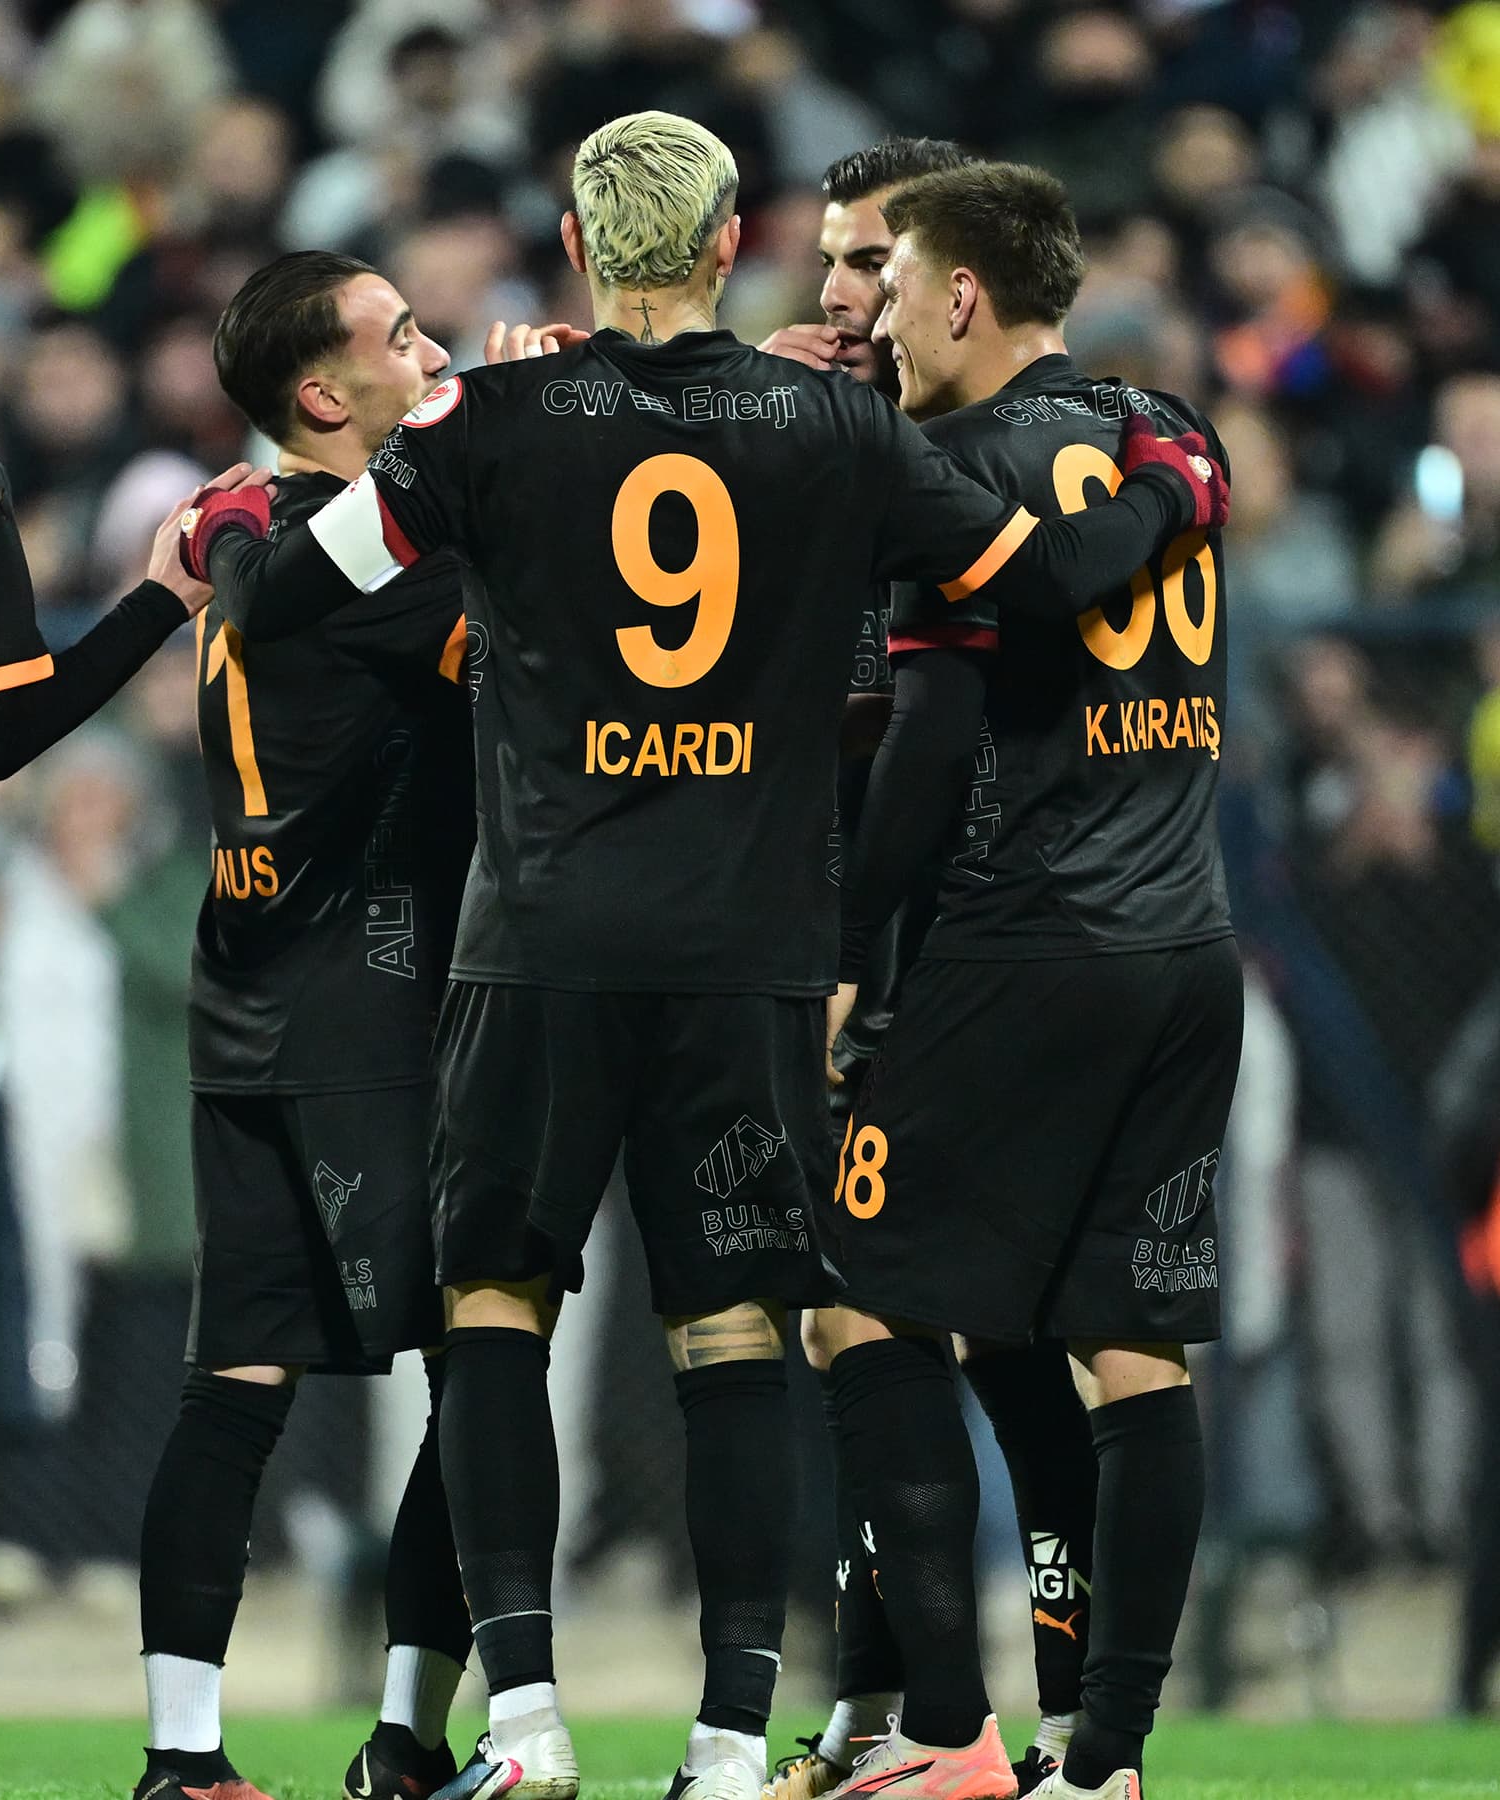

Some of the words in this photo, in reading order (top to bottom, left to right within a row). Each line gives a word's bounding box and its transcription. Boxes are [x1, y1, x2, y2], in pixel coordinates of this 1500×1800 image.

[542, 379, 624, 416] CW
[682, 385, 798, 430] Enerji
[993, 395, 1062, 427] CW
[611, 453, 740, 689] 9
[585, 721, 753, 777] ICARDI
[701, 1205, 805, 1235] BULLS
[1132, 1237, 1216, 1268] BULS
